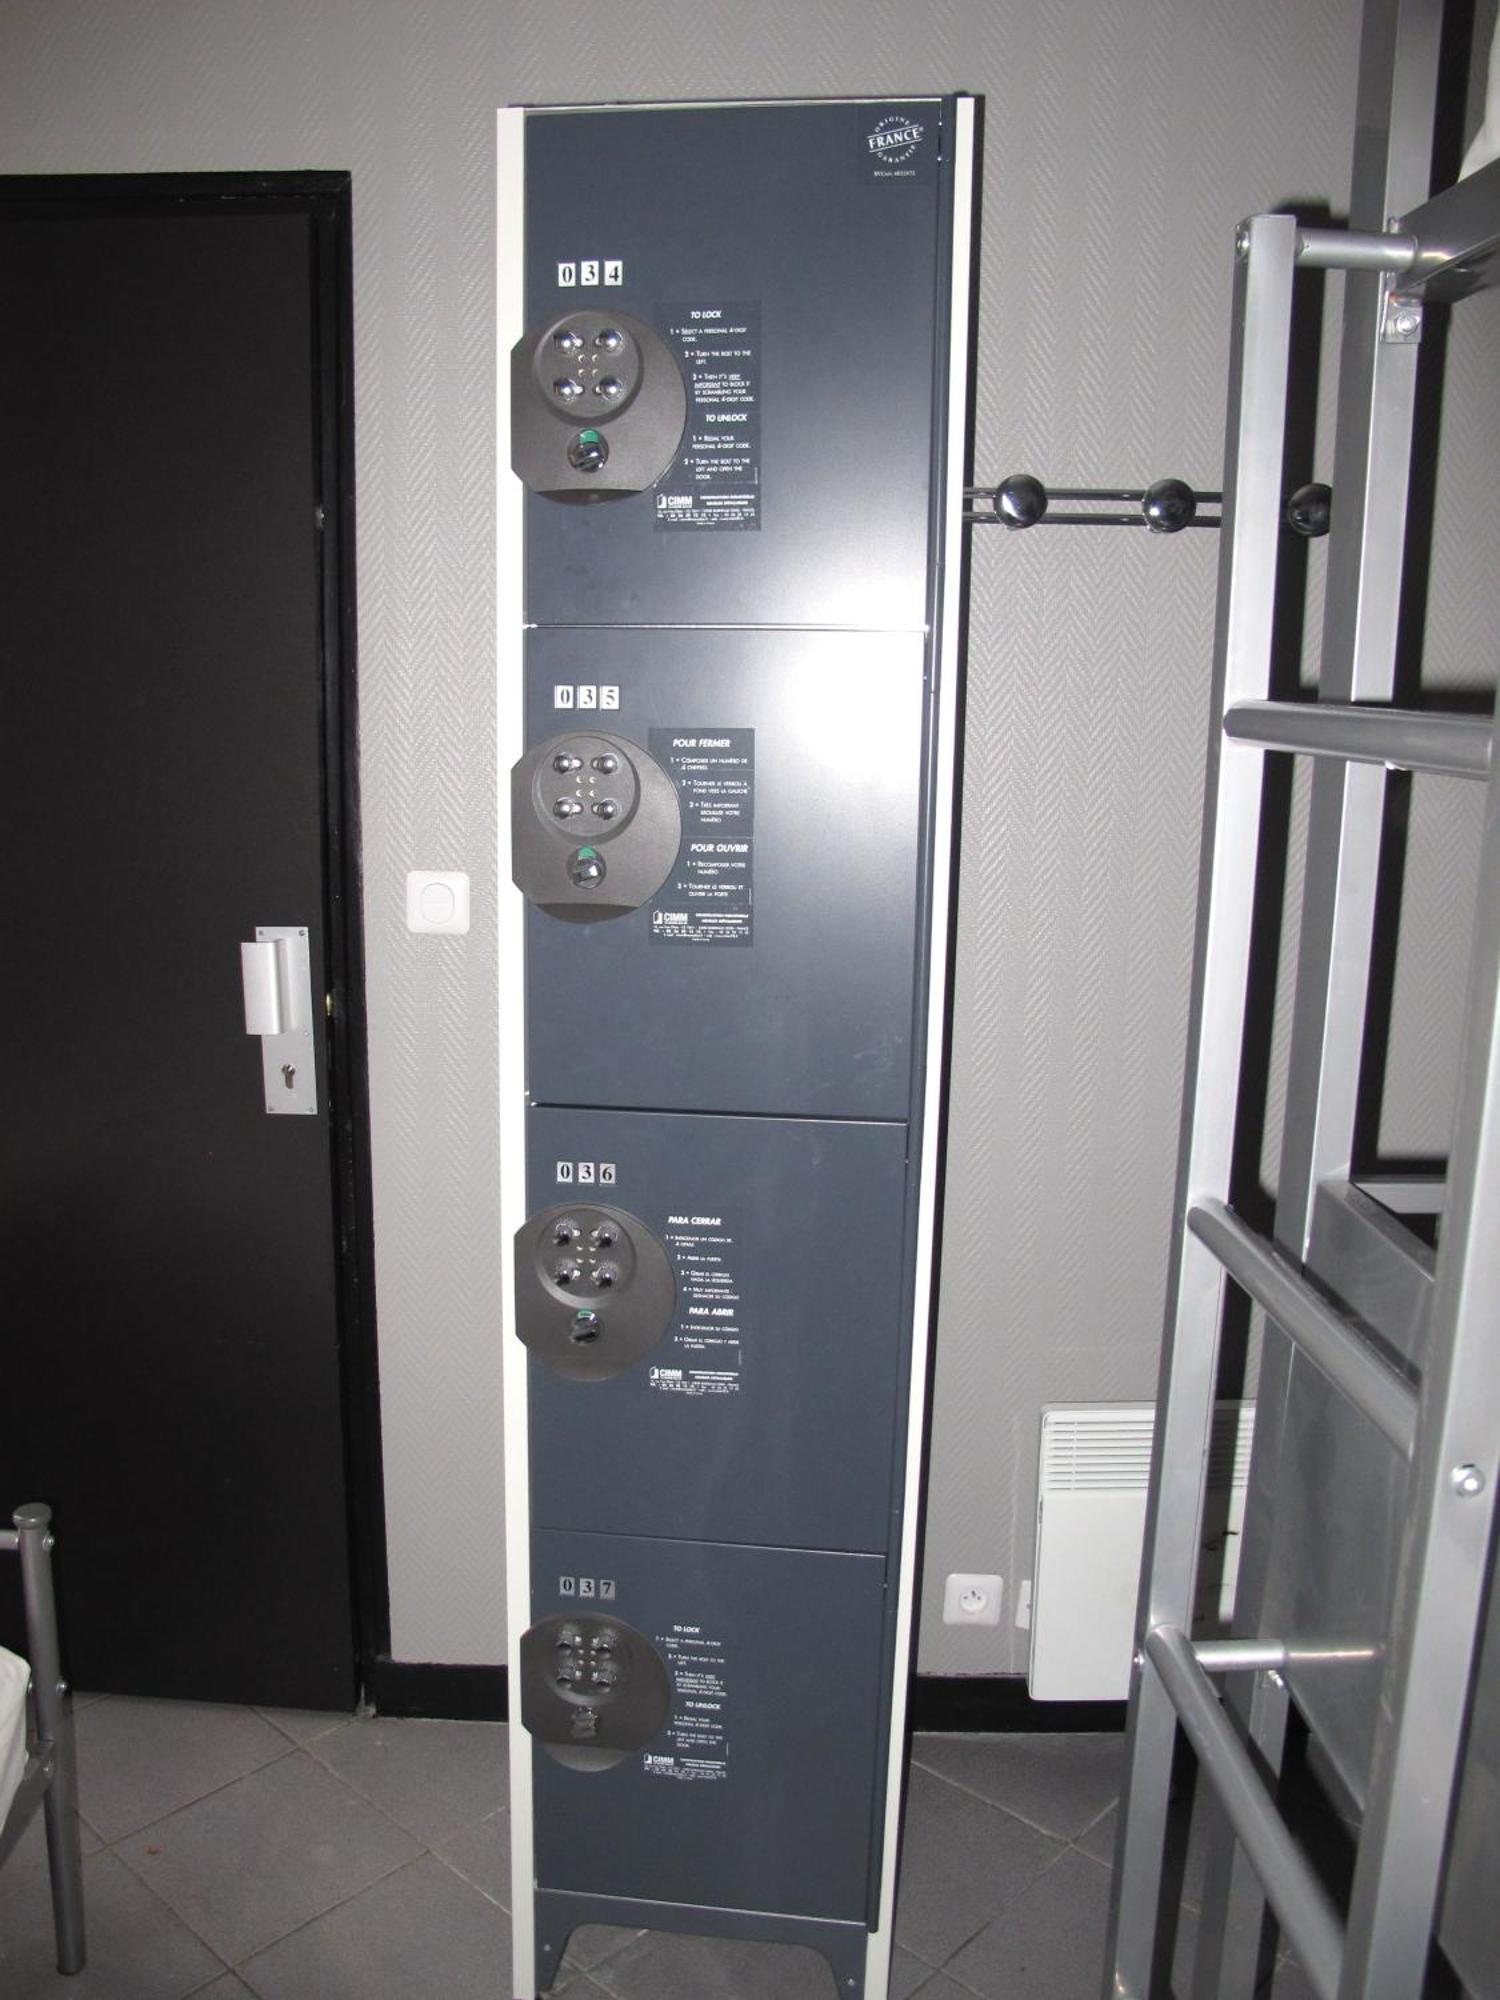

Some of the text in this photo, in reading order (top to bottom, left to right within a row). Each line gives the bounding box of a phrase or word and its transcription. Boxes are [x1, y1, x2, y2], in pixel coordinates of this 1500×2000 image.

[868, 128, 920, 150] FRANCE
[561, 263, 620, 284] 034
[668, 496, 692, 505] CIMM
[558, 687, 617, 707] 035
[673, 739, 730, 747] POUR FERMER
[691, 844, 748, 852] POUR OUVRIR
[664, 913, 688, 921] CIMM
[560, 1164, 613, 1181] 036
[668, 1216, 721, 1225] PARA CERRAR
[689, 1307, 733, 1316] PARA ABRIR
[562, 1578, 612, 1595] 037
